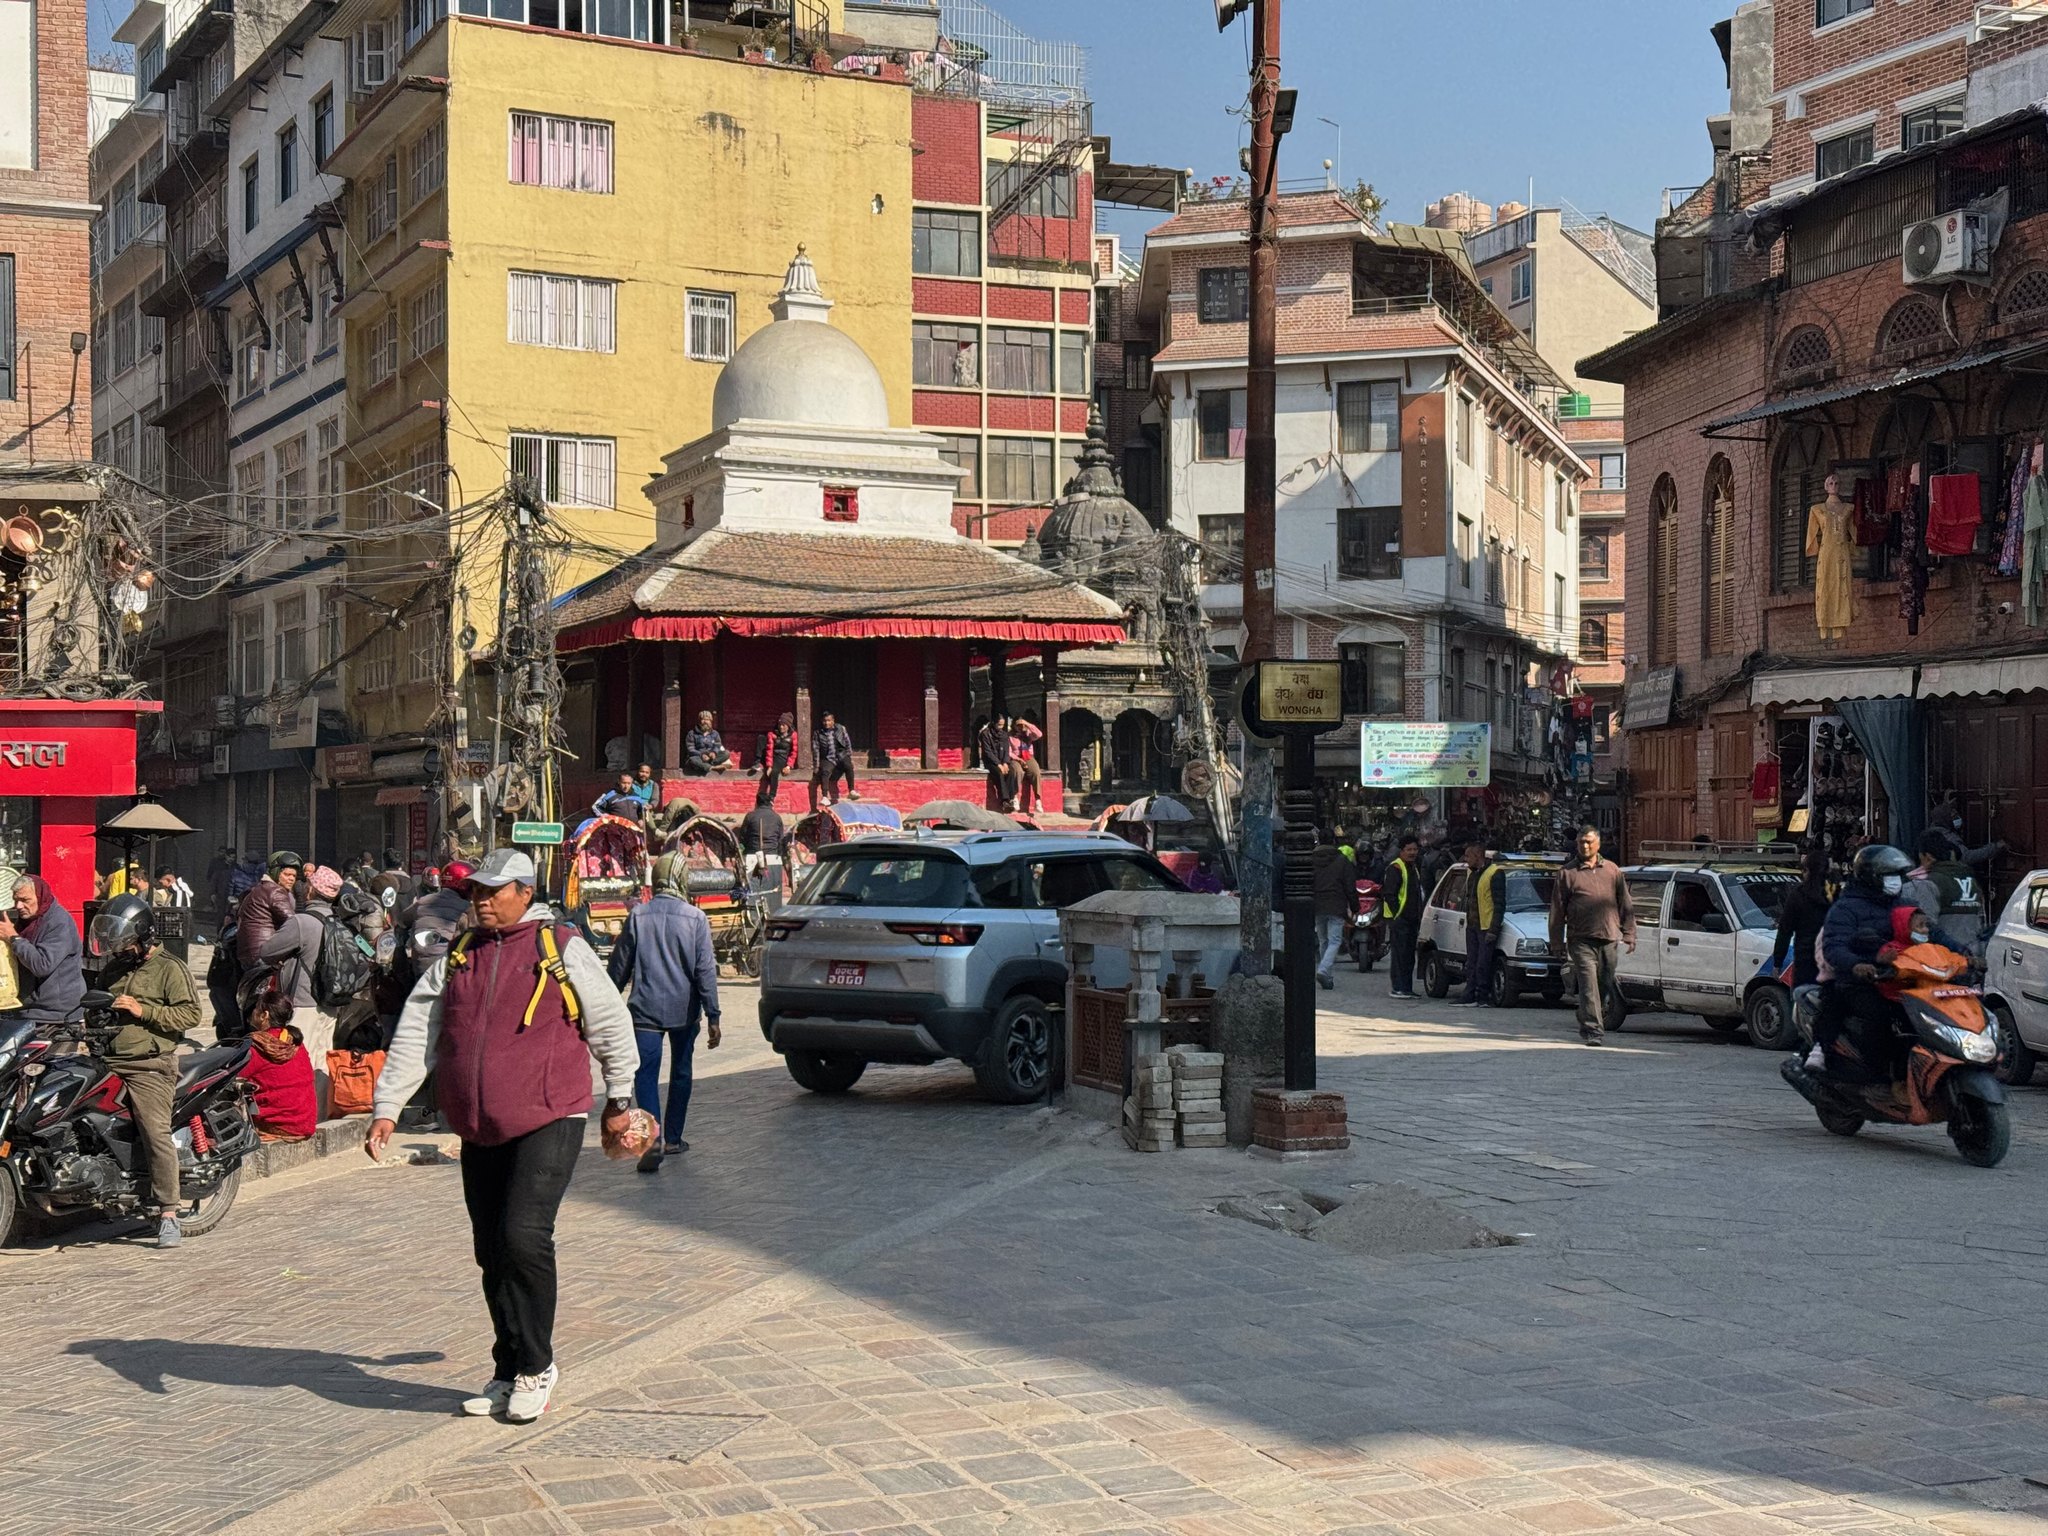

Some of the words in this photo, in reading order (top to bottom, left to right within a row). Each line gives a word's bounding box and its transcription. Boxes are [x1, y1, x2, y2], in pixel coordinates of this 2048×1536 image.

[1947, 235, 1956, 244] LG
[1278, 705, 1322, 715] WONGHA
[0, 741, 68, 767] सल
[1735, 874, 1802, 884] SUZUKI
